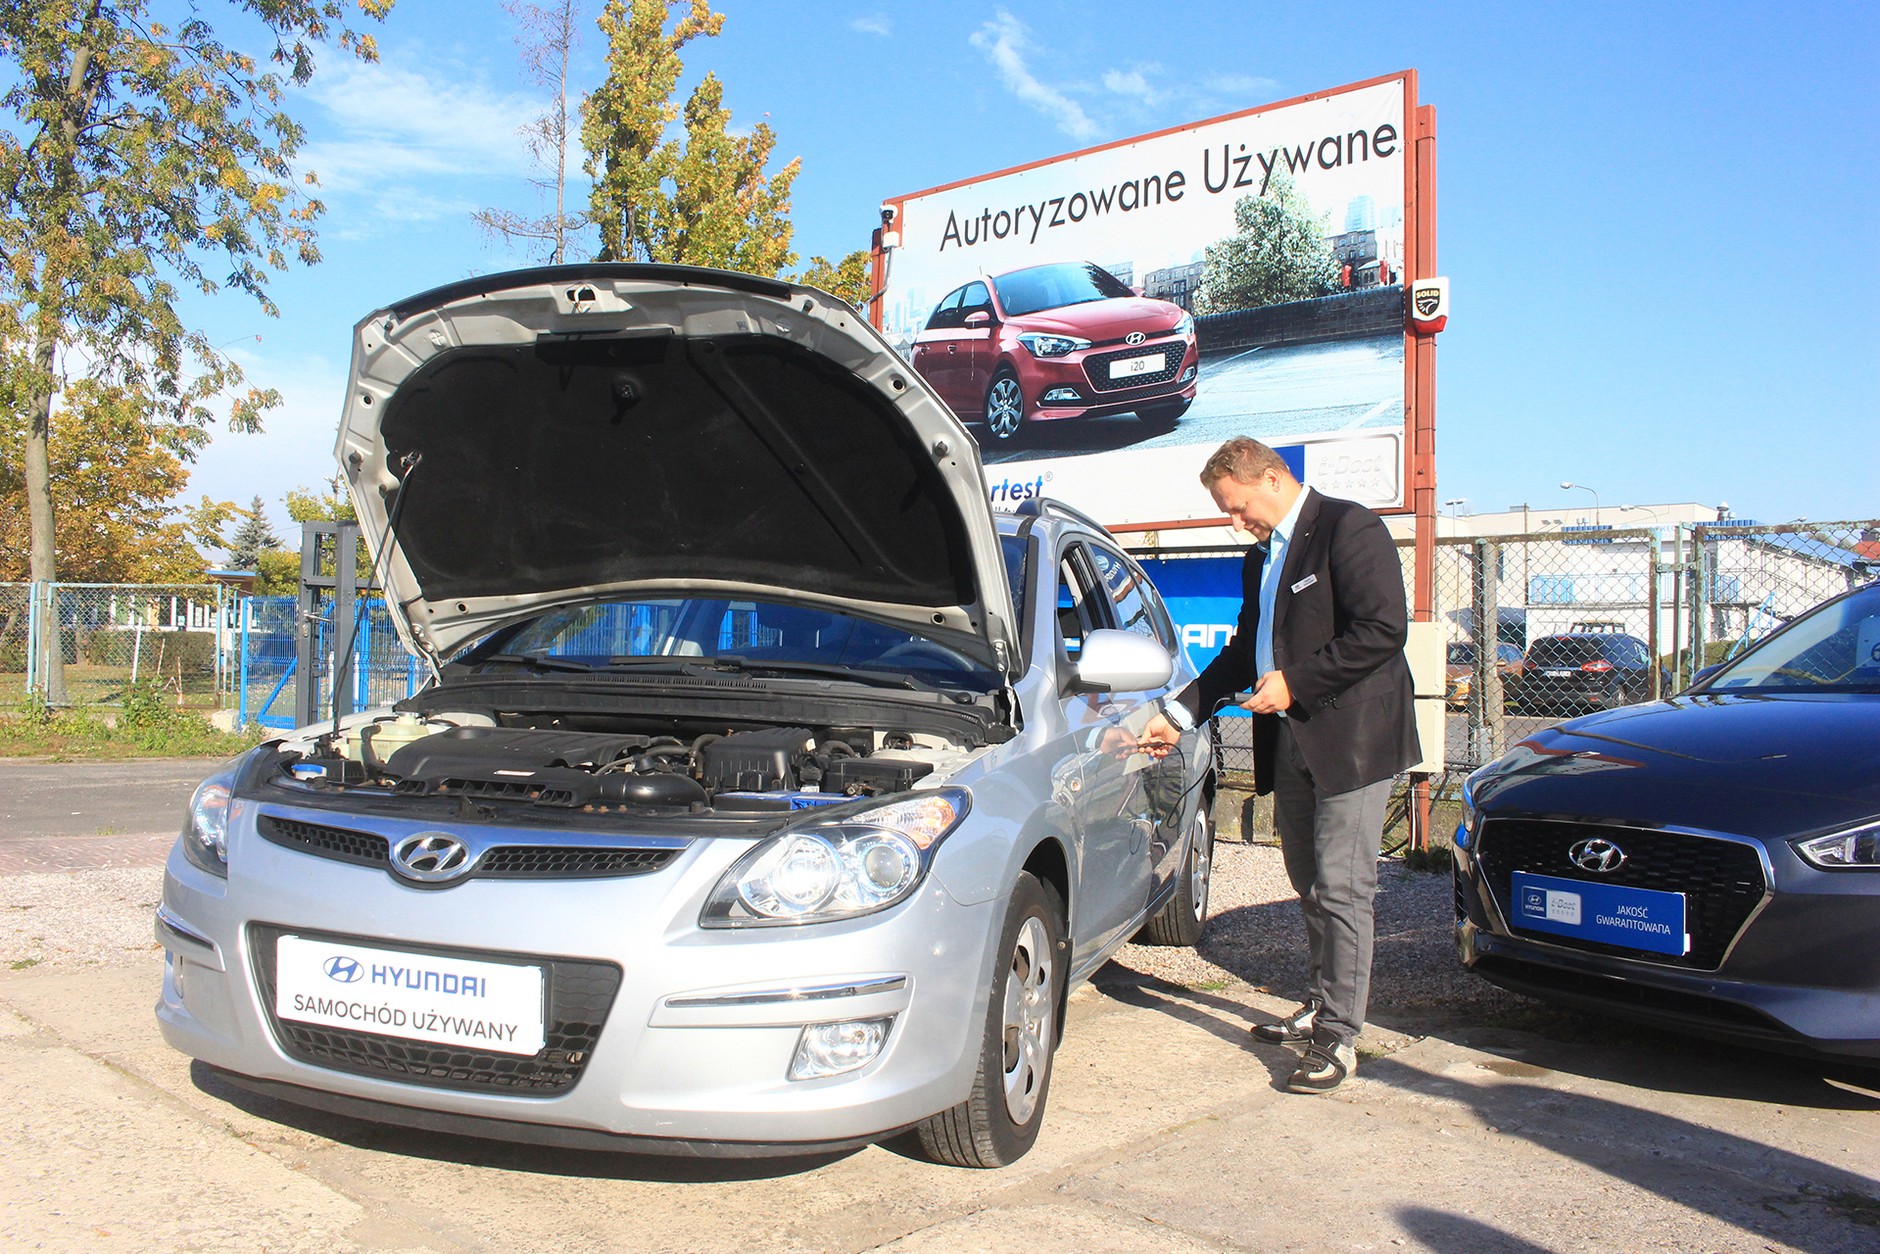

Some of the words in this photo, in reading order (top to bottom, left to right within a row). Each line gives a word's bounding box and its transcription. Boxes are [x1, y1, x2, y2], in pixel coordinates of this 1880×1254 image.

[939, 169, 1186, 252] Autoryzowane
[1203, 122, 1398, 197] Używane
[1416, 290, 1440, 299] SOLID
[1130, 360, 1146, 372] i20
[1175, 623, 1239, 649] AN
[1616, 905, 1649, 919] JAKOŚĆ
[1596, 914, 1671, 936] GWARANTOWANA
[371, 963, 486, 998] HYUNDAI
[294, 994, 407, 1028] SAMOCHÓD
[412, 1008, 519, 1043] UŻYWANY
